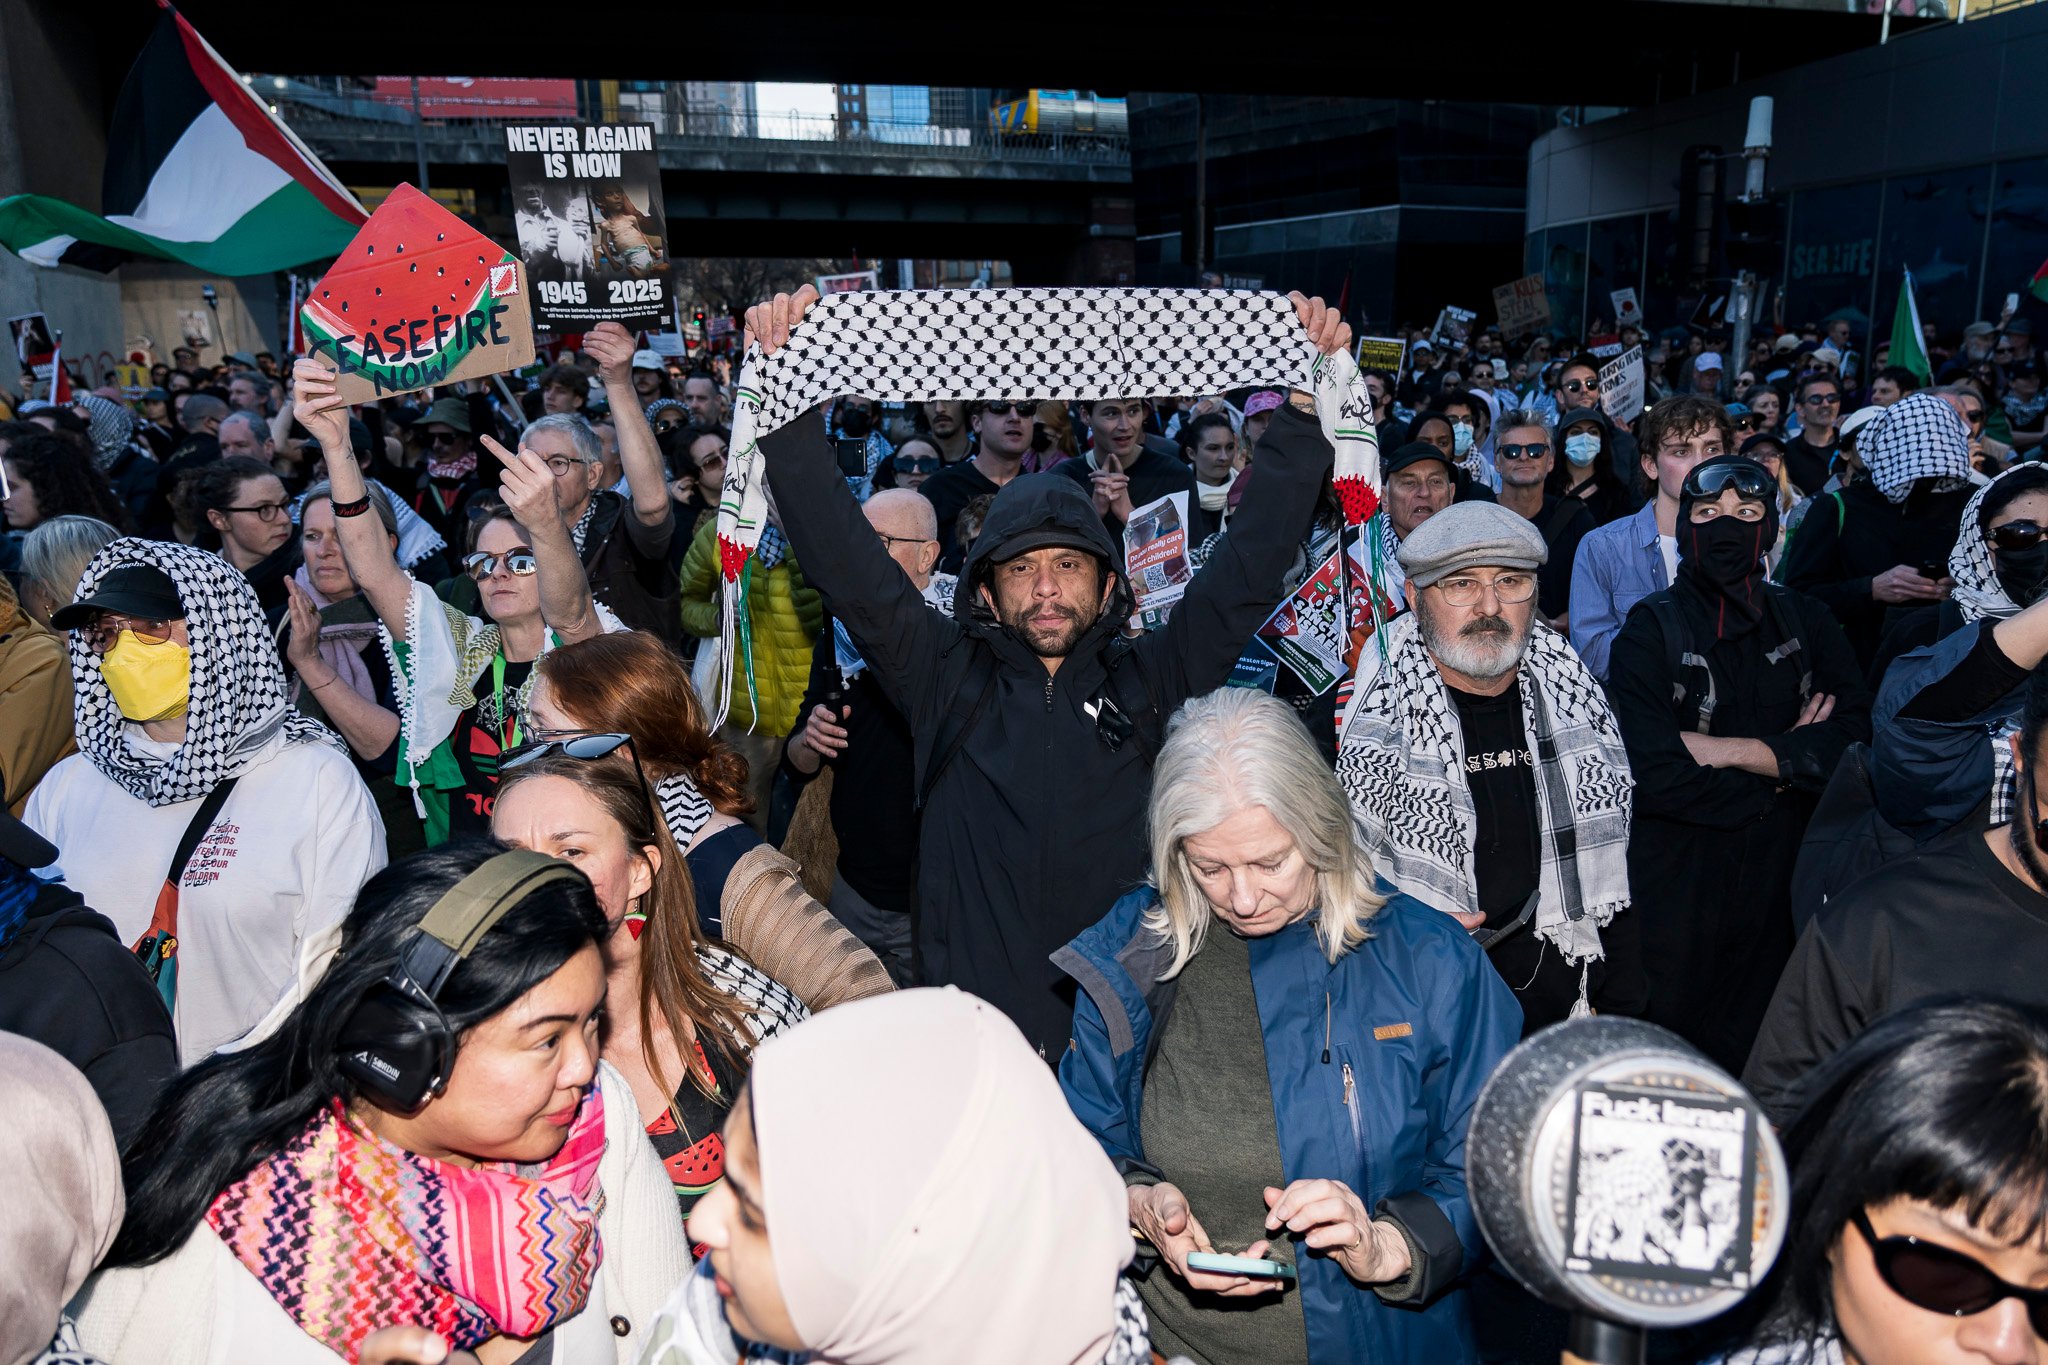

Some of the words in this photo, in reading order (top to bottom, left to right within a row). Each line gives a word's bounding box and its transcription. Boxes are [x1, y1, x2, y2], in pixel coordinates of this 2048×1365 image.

[506, 127, 580, 152] NEVER
[585, 126, 653, 151] AGAIN
[543, 153, 568, 178] IS
[571, 153, 622, 178] NOW
[537, 280, 588, 304] 1945
[608, 278, 663, 304] 2025
[620, 311, 641, 319] genocide
[373, 352, 448, 396] NOW
[1600, 371, 1627, 394] CRIMES
[1147, 539, 1166, 553] really
[1166, 533, 1183, 544] care
[1147, 546, 1178, 563] children?
[1295, 615, 1336, 656] ISRAEL
[1242, 664, 1256, 672] code
[1306, 661, 1326, 681] MARKET
[222, 848, 238, 857] THE
[183, 871, 220, 880] CHILDREN
[372, 1056, 401, 1079] SORDIN
[1582, 1090, 1661, 1122] Fuck
